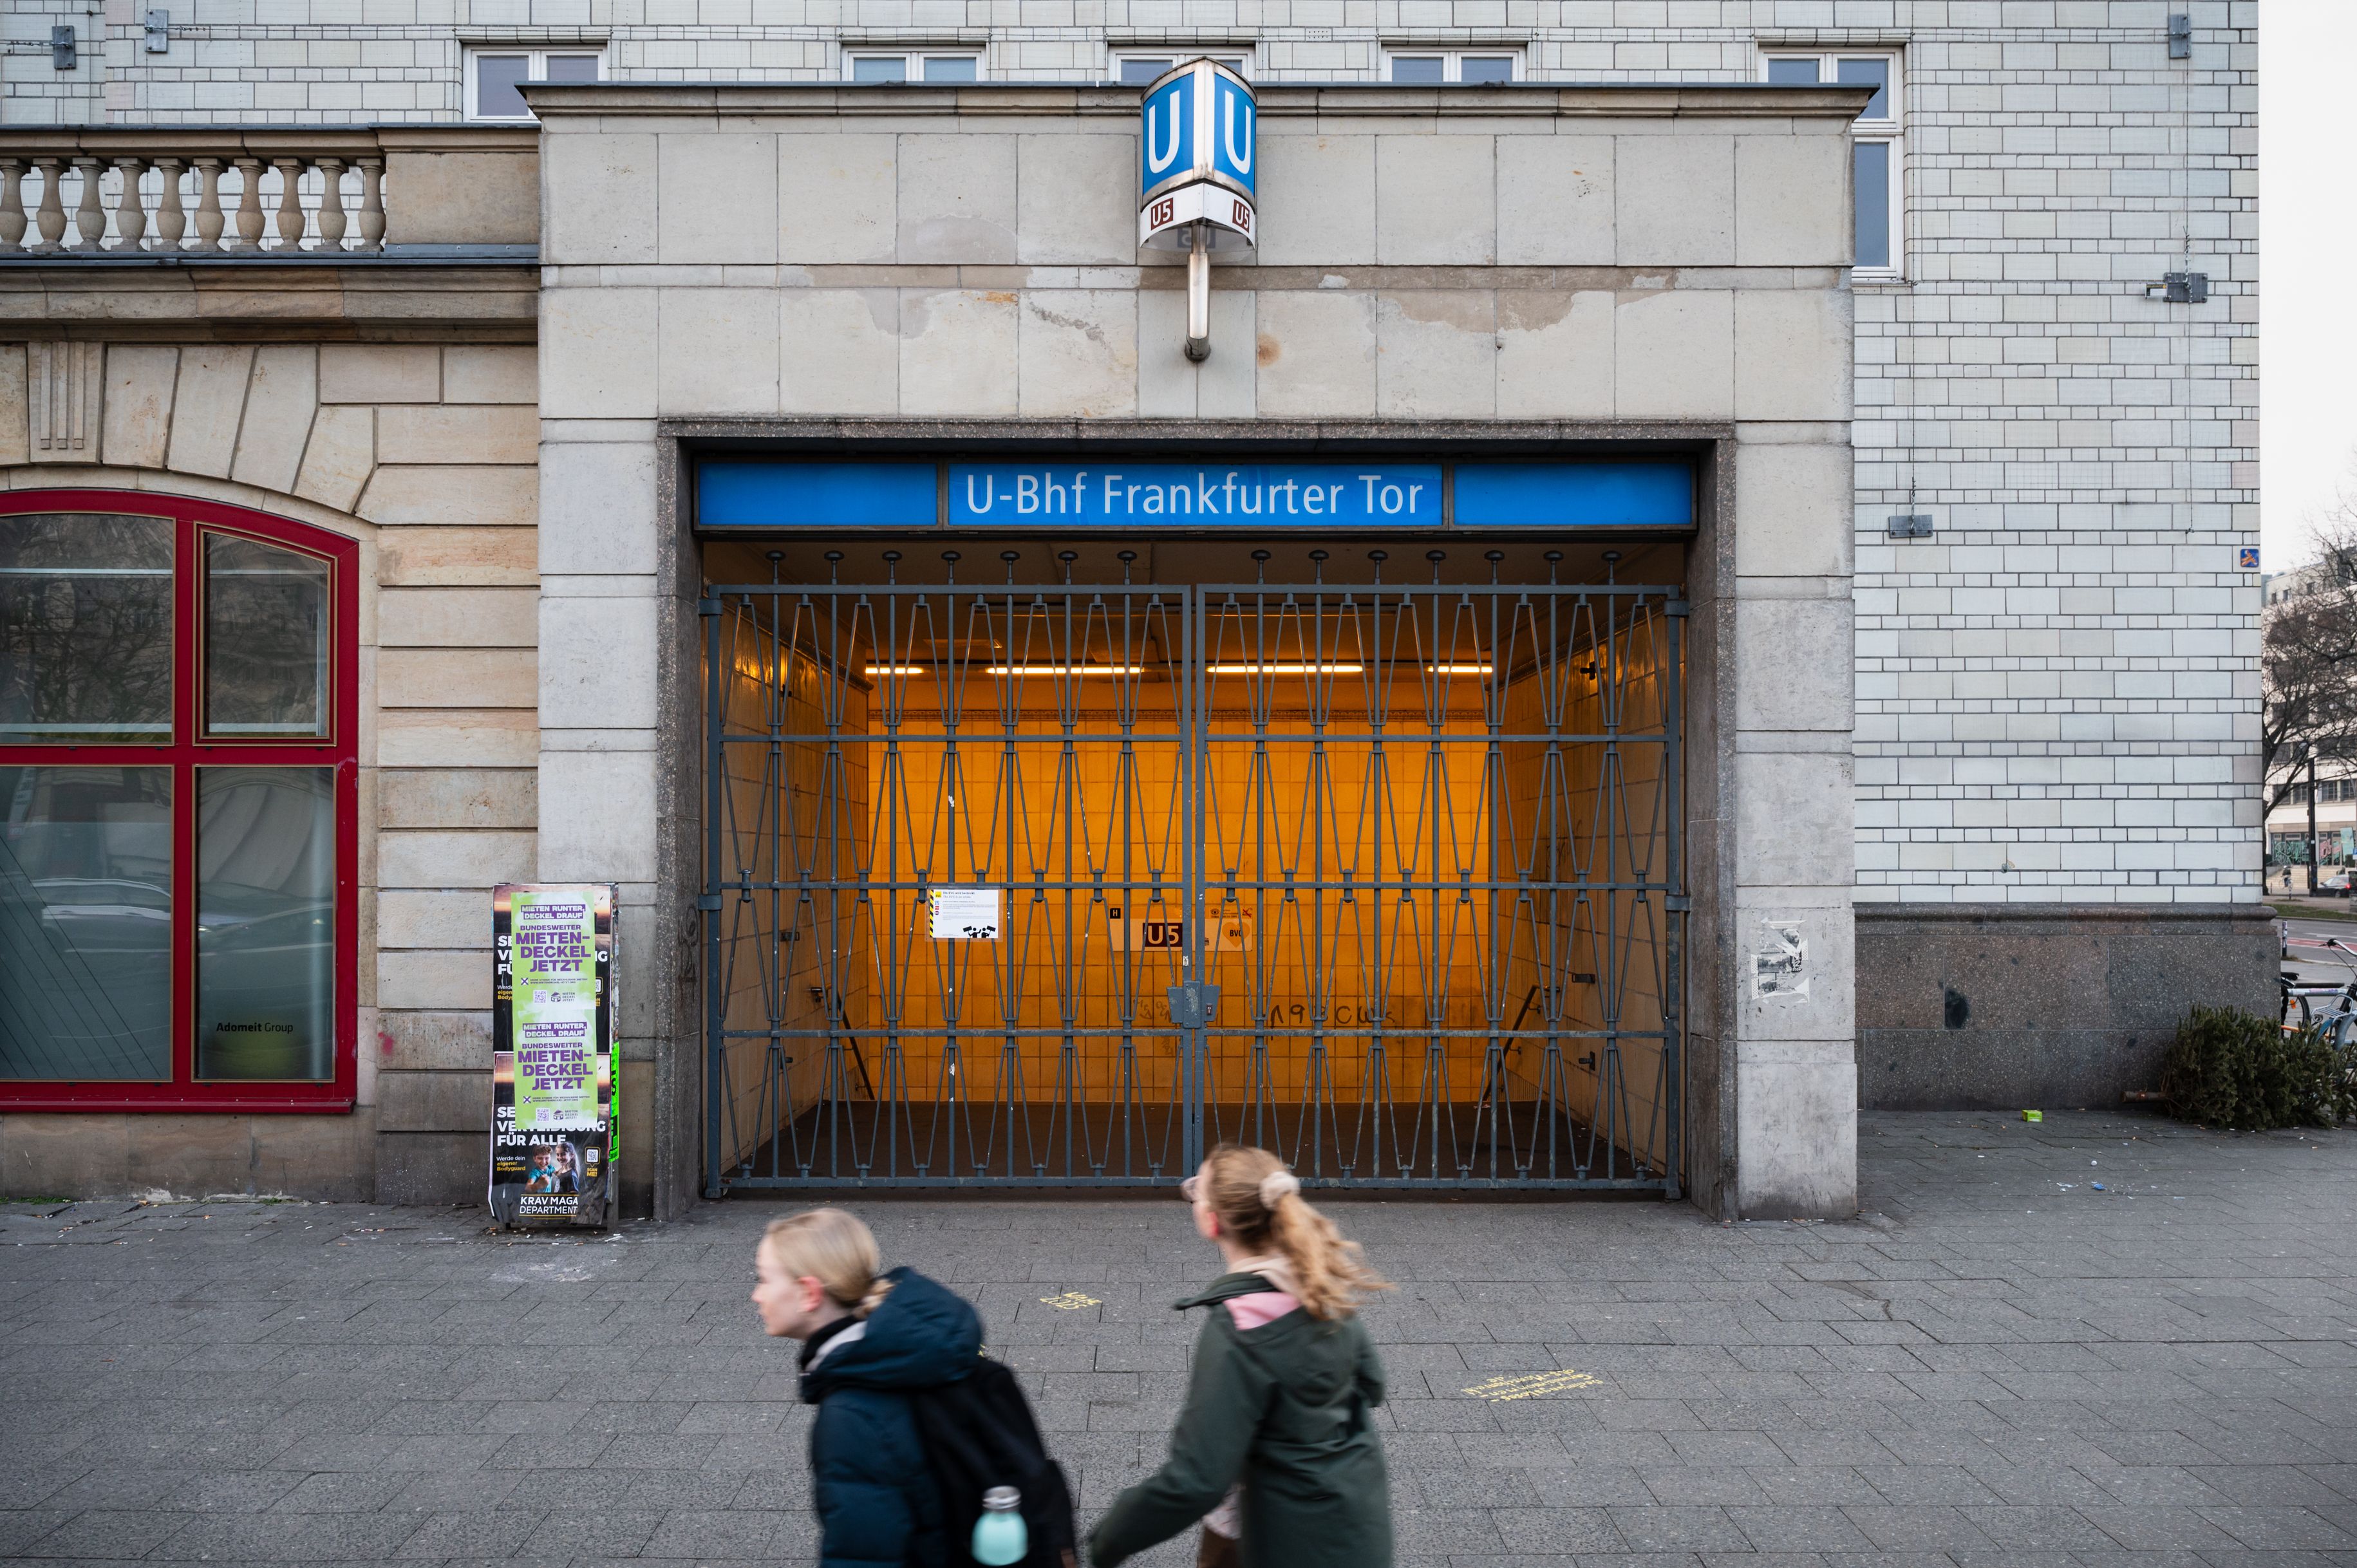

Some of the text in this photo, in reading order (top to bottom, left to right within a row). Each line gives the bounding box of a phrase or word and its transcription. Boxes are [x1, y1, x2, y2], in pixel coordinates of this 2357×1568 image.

[1148, 89, 1180, 174] U
[1225, 89, 1252, 175] U
[1152, 201, 1171, 227] U5
[1235, 200, 1249, 230] U5
[967, 471, 1423, 514] U-Bhf Frankfurter Tor
[516, 931, 590, 945] MIETEN-
[1148, 925, 1179, 944] U5
[520, 946, 591, 958] DECKEL
[530, 959, 583, 973] JETZT
[216, 1022, 294, 1034] Adomeit Group
[518, 1049, 592, 1063] MIETEN-
[523, 1063, 593, 1076] DECKEL
[532, 1077, 585, 1090] JETZT
[497, 1132, 567, 1146] FÜR ALLE
[520, 1197, 578, 1205] KRAV MAGA
[520, 1206, 578, 1215] DEPARTMENT
